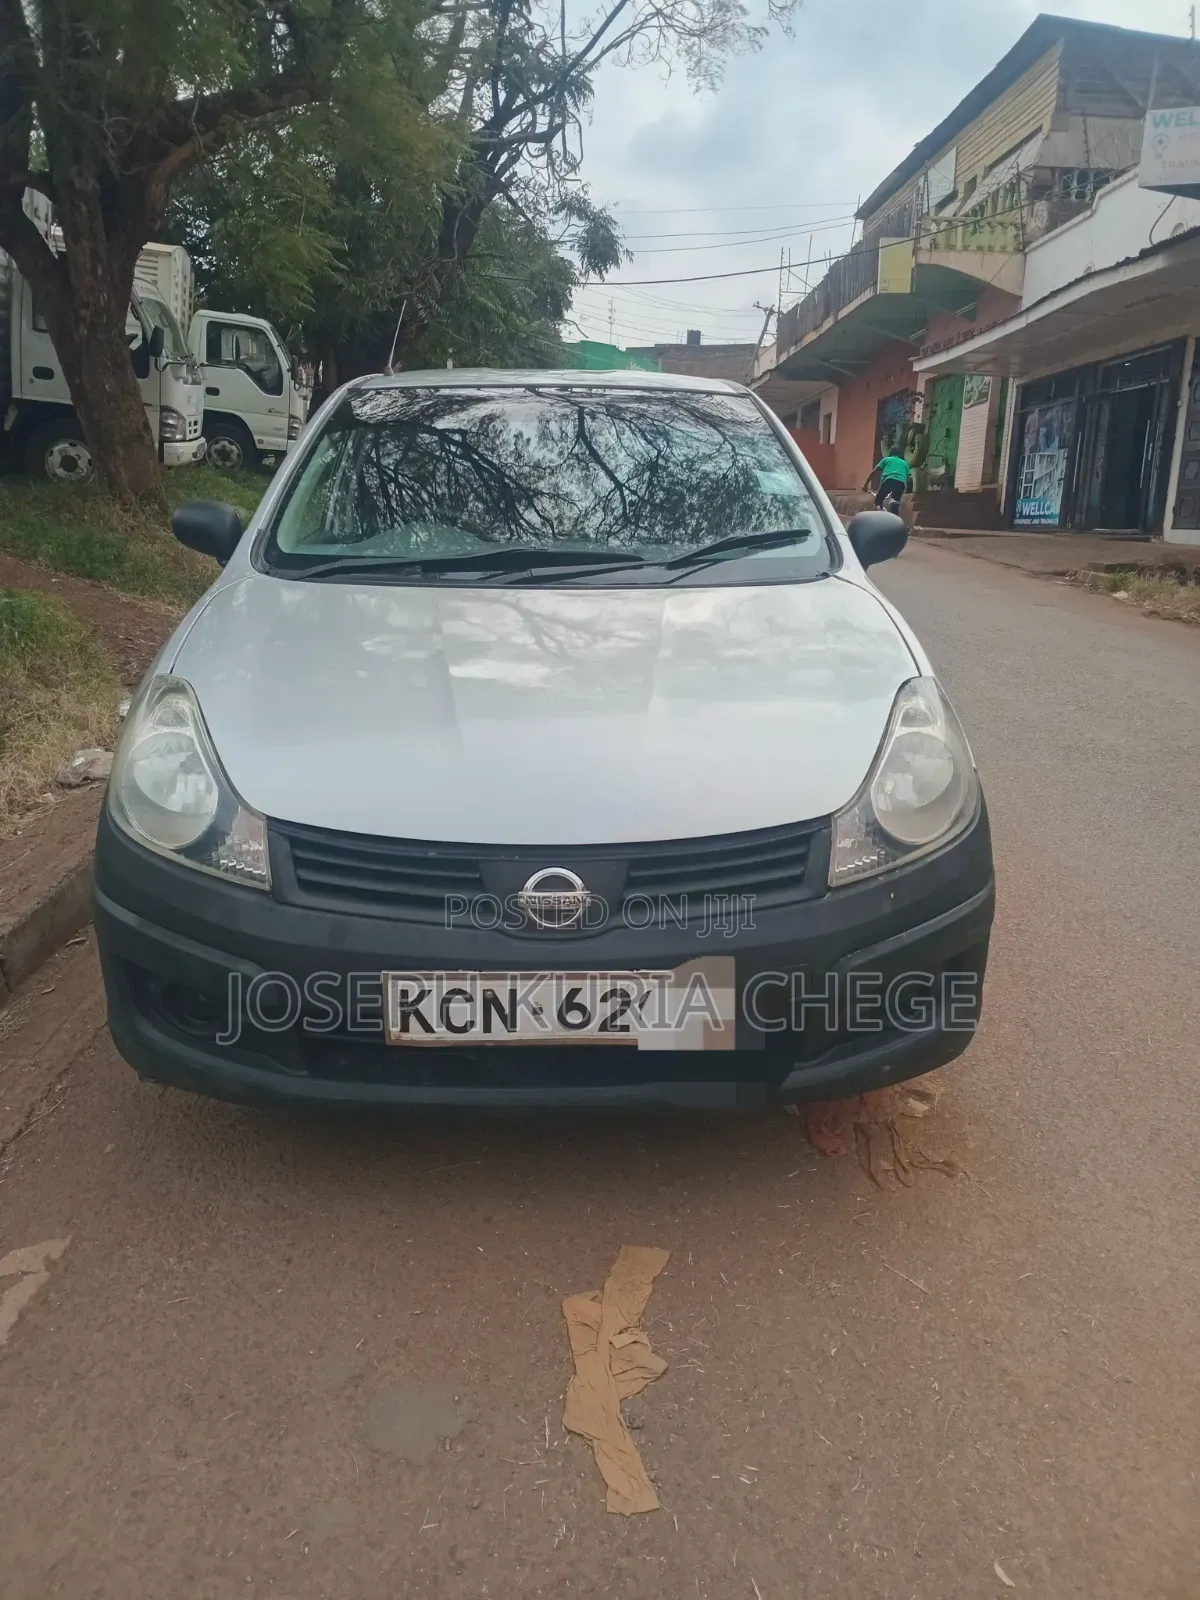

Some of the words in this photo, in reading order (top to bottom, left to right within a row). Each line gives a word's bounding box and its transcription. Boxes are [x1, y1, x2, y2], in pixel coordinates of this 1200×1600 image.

[526, 895, 585, 905] NISSAN
[398, 987, 518, 1034] KCN
[556, 986, 652, 1033] 62
